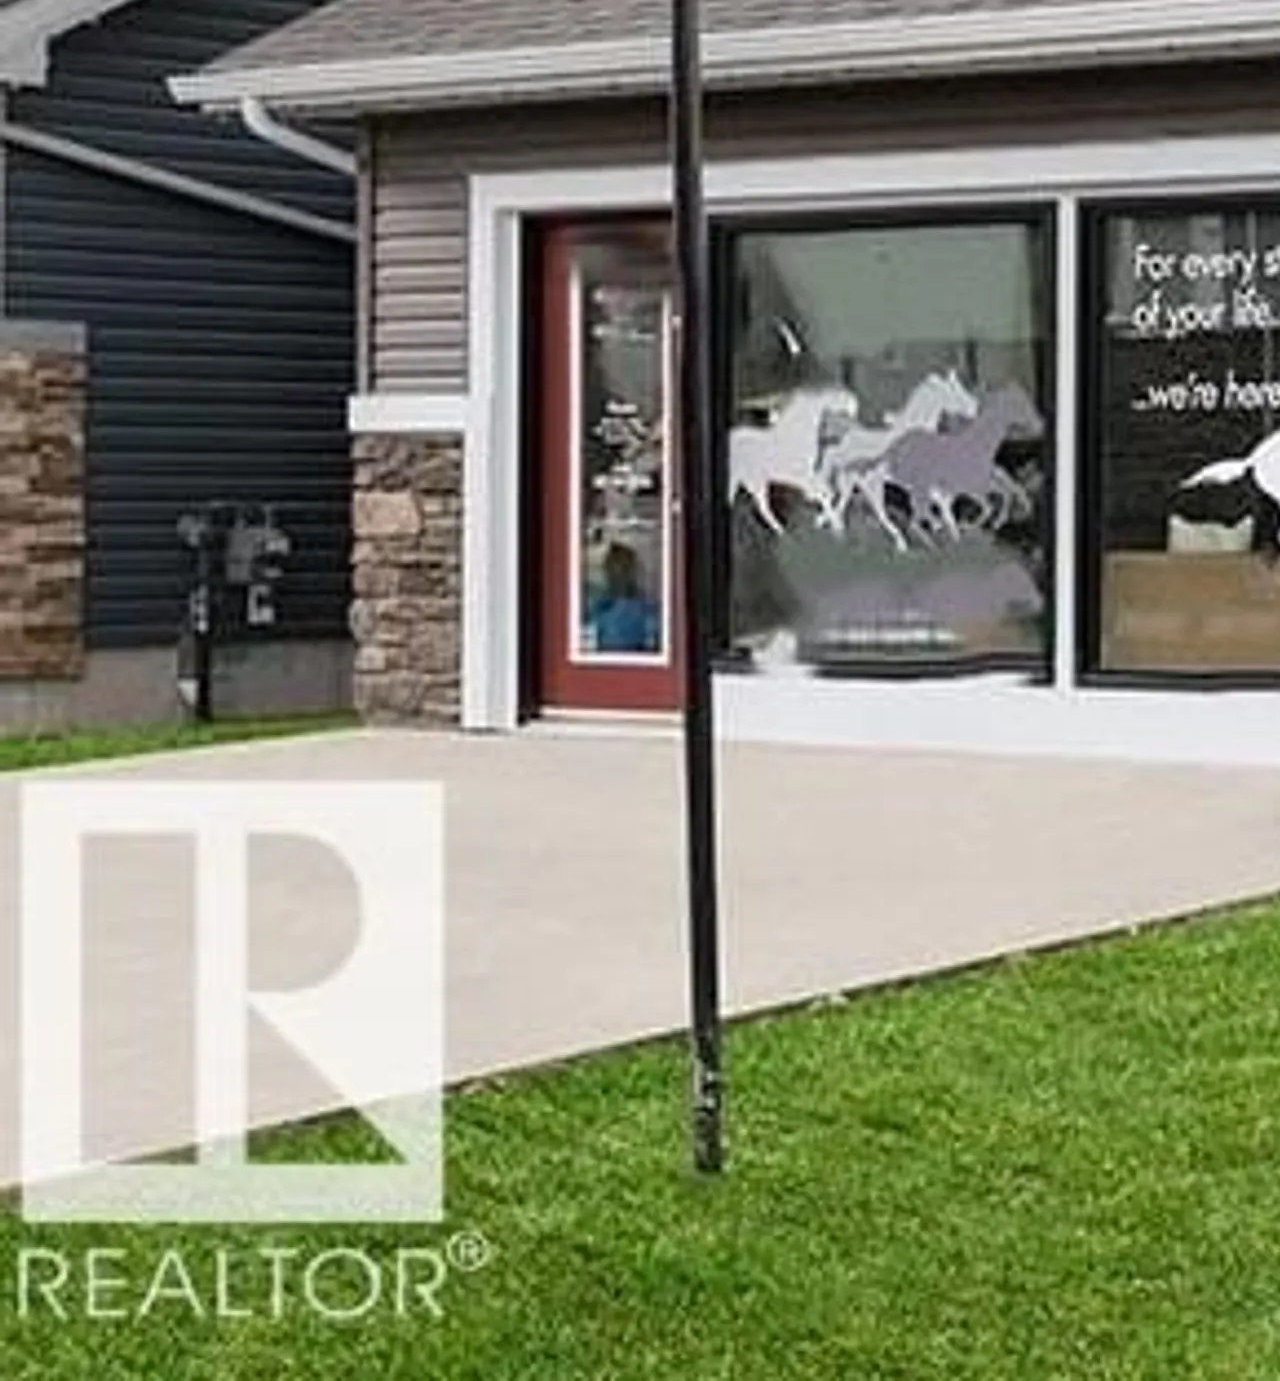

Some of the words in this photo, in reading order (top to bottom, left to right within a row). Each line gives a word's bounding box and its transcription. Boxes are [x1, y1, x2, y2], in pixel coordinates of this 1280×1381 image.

[1135, 244, 1176, 280] For
[1181, 250, 1257, 288] every
[1133, 289, 1163, 329] of
[1163, 304, 1227, 339] your
